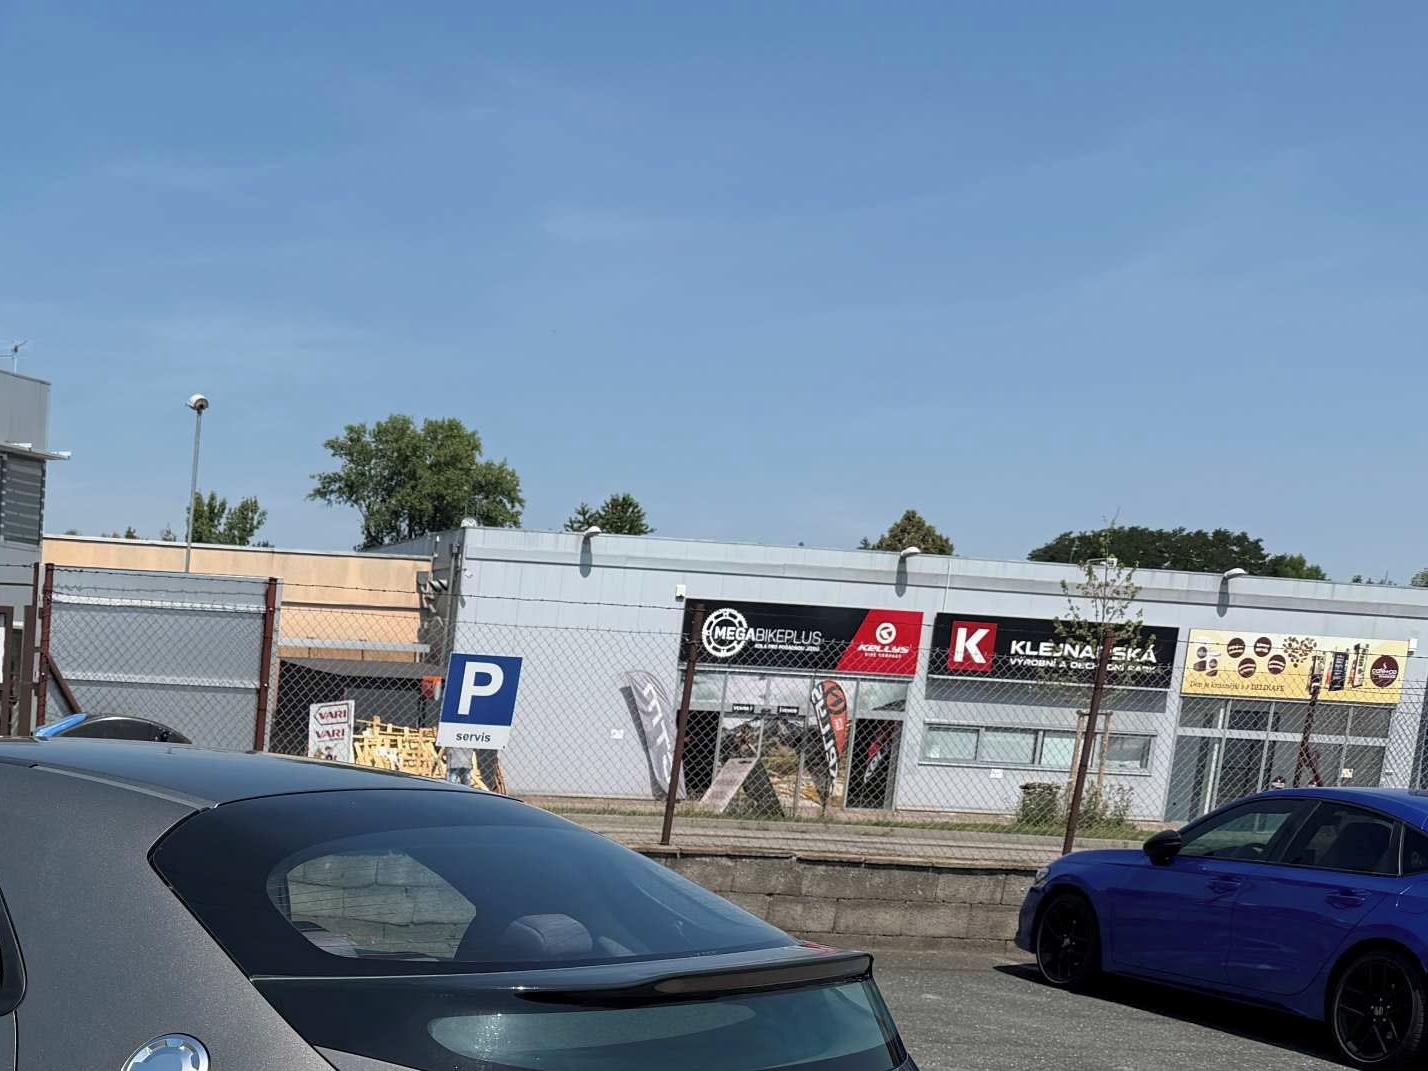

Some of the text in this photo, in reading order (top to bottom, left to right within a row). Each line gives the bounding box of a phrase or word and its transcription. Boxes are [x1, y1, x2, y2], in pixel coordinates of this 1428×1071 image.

[714, 625, 823, 646] MEGABIKEPLUS
[954, 627, 990, 664] K
[457, 661, 504, 715] P
[318, 709, 347, 720] VARI
[315, 728, 345, 739] VARI
[455, 731, 492, 743] servis
